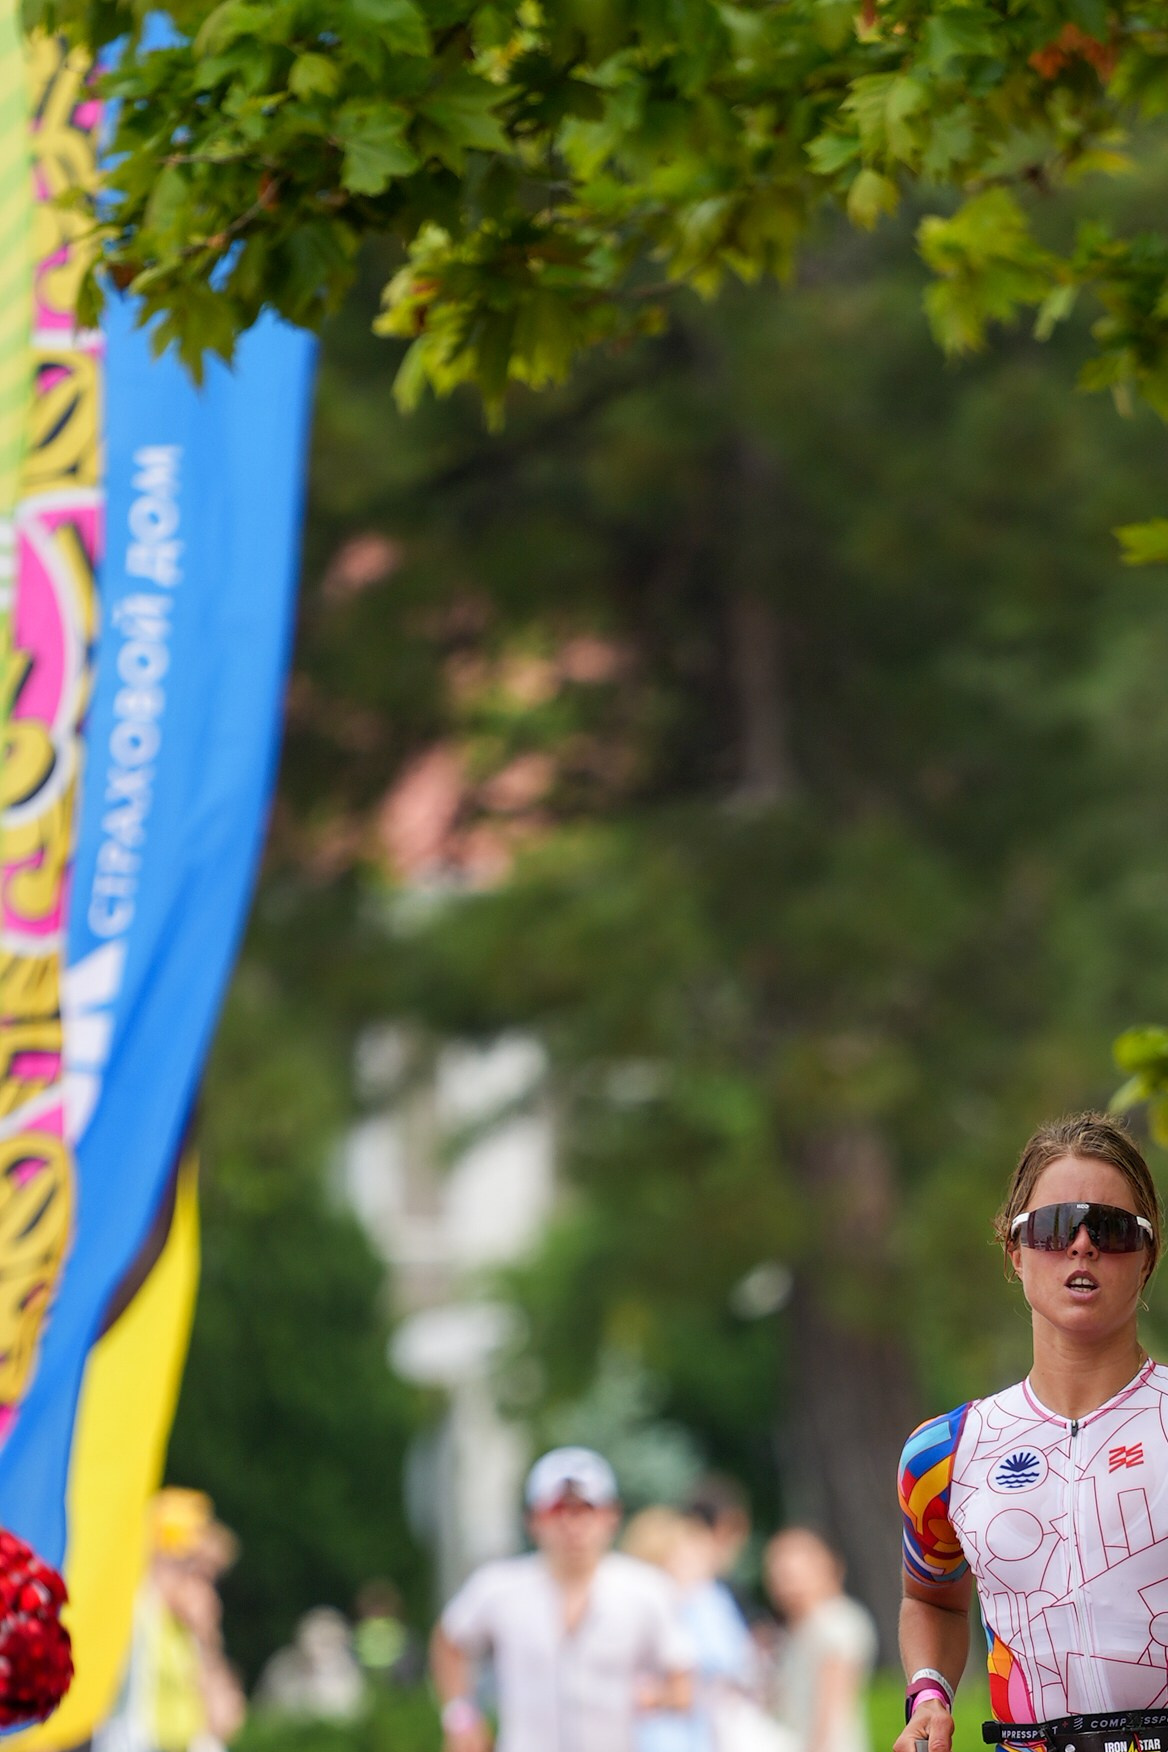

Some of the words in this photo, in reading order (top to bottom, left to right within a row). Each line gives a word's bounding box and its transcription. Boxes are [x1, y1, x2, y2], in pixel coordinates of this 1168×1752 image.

[125, 445, 184, 587] ДОМ
[87, 594, 172, 937] СТРАХОВОЙ
[1137, 1738, 1162, 1751] STAR
